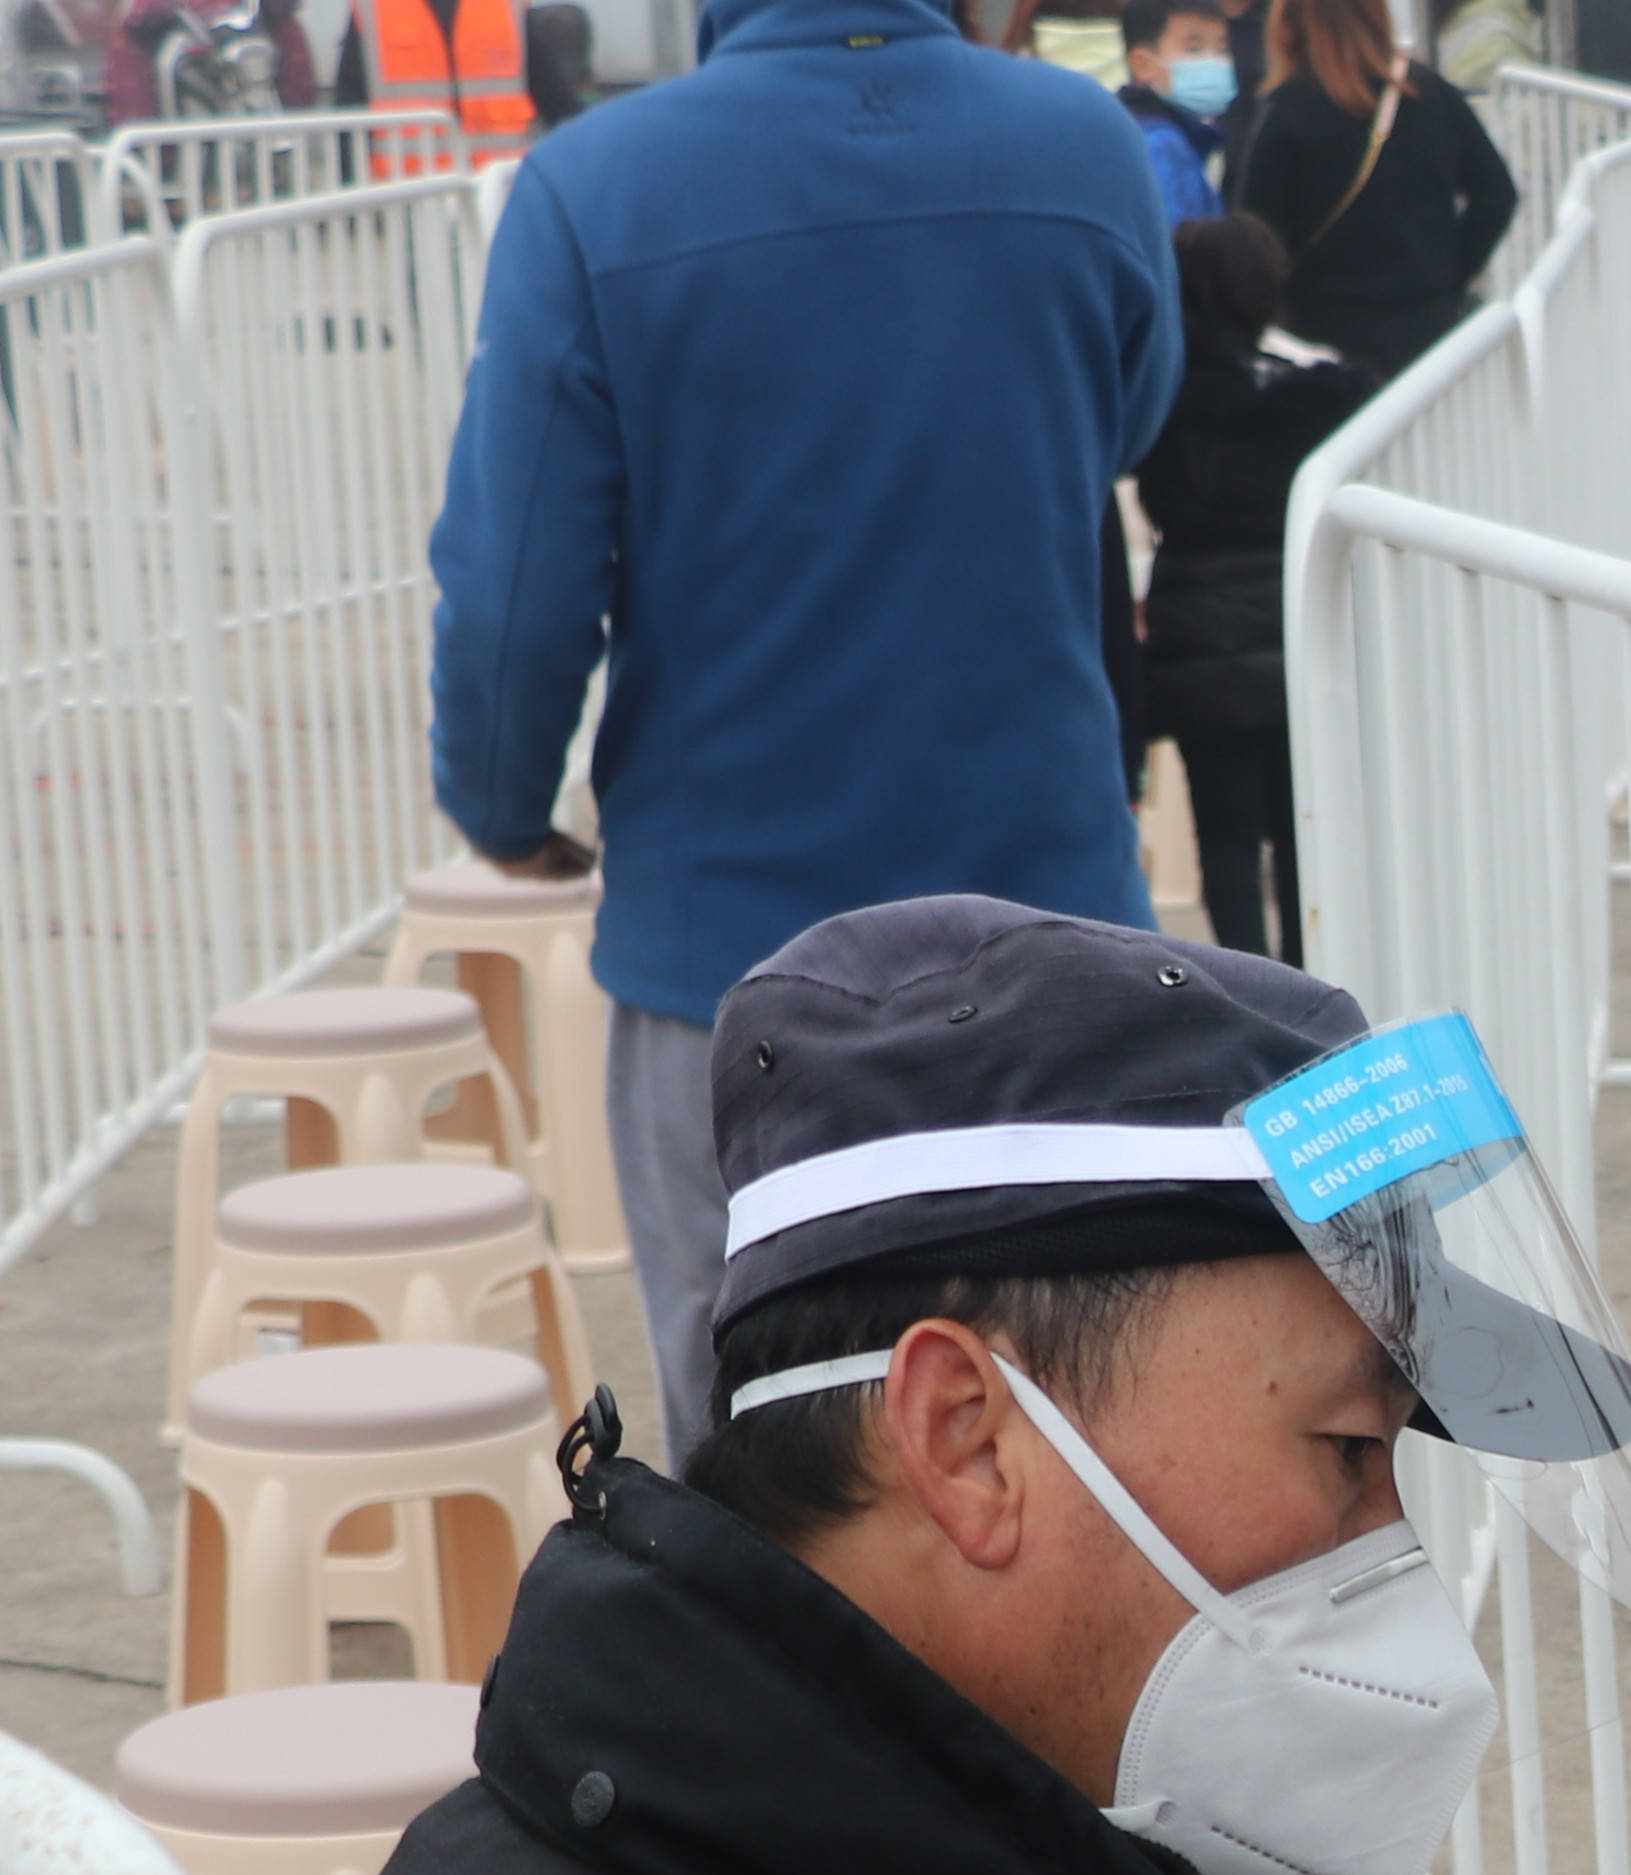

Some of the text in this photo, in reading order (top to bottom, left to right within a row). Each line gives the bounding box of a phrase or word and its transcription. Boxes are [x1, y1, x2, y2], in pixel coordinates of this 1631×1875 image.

[1264, 1109, 1299, 1138] GB
[1289, 1102, 1393, 1169] ANSI/ISEA
[1308, 1122, 1439, 1199] EN166:2001
